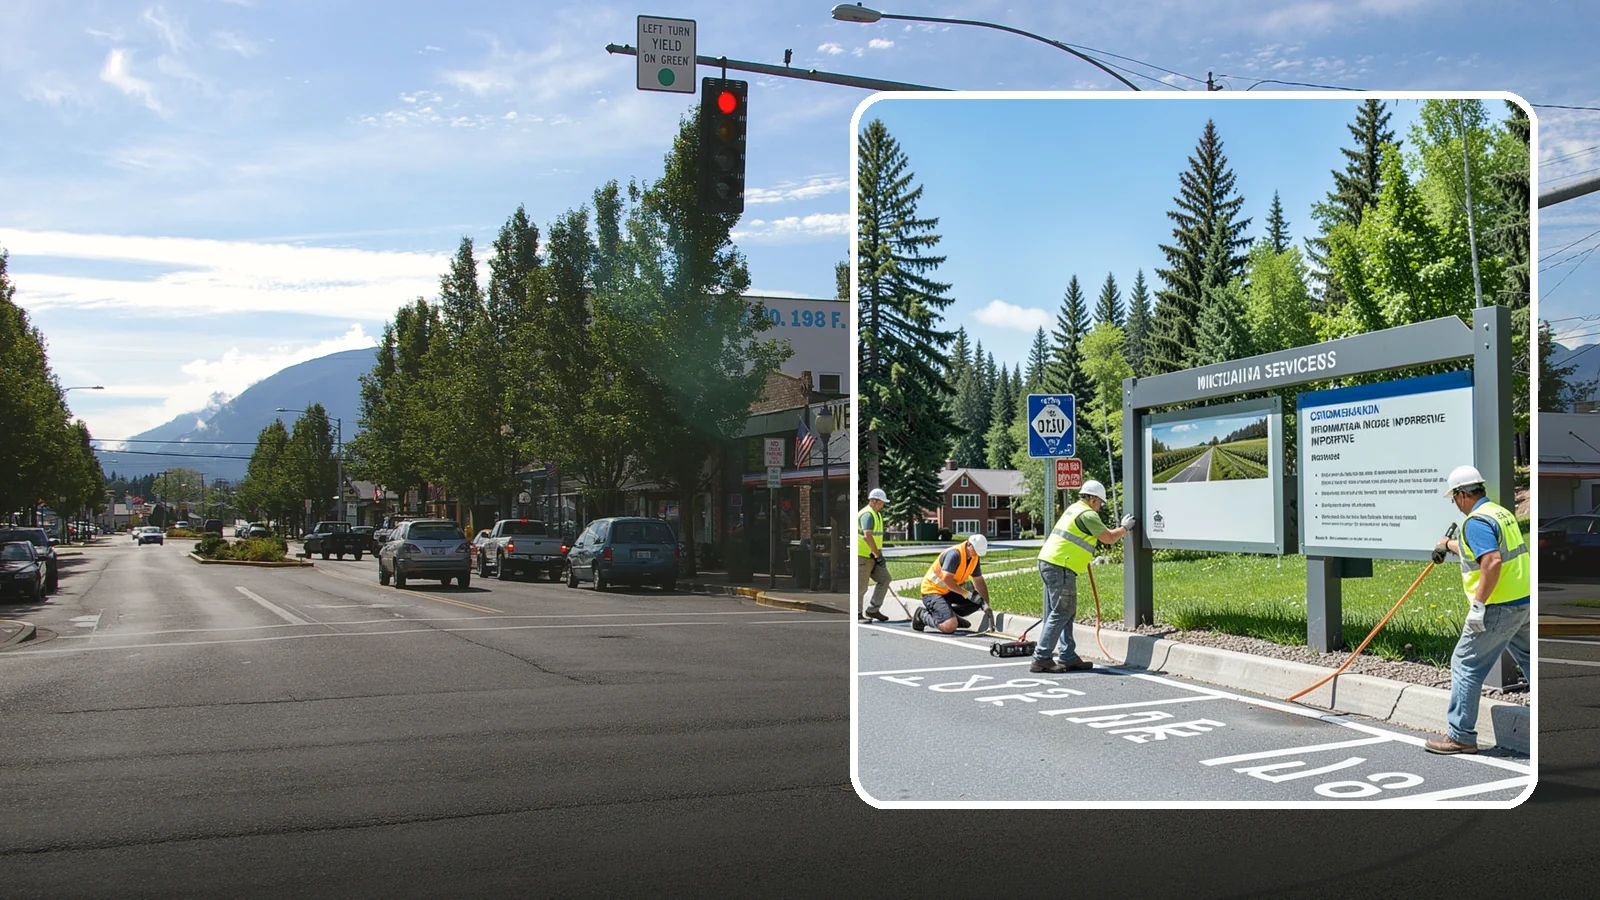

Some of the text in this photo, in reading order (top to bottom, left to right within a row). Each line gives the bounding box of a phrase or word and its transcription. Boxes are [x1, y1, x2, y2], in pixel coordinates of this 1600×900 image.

[643, 23, 690, 37] LEFT TURN
[652, 38, 682, 51] YIELD
[644, 53, 689, 66] ON GREEN
[791, 309, 826, 328] 198
[831, 311, 847, 329] F.
